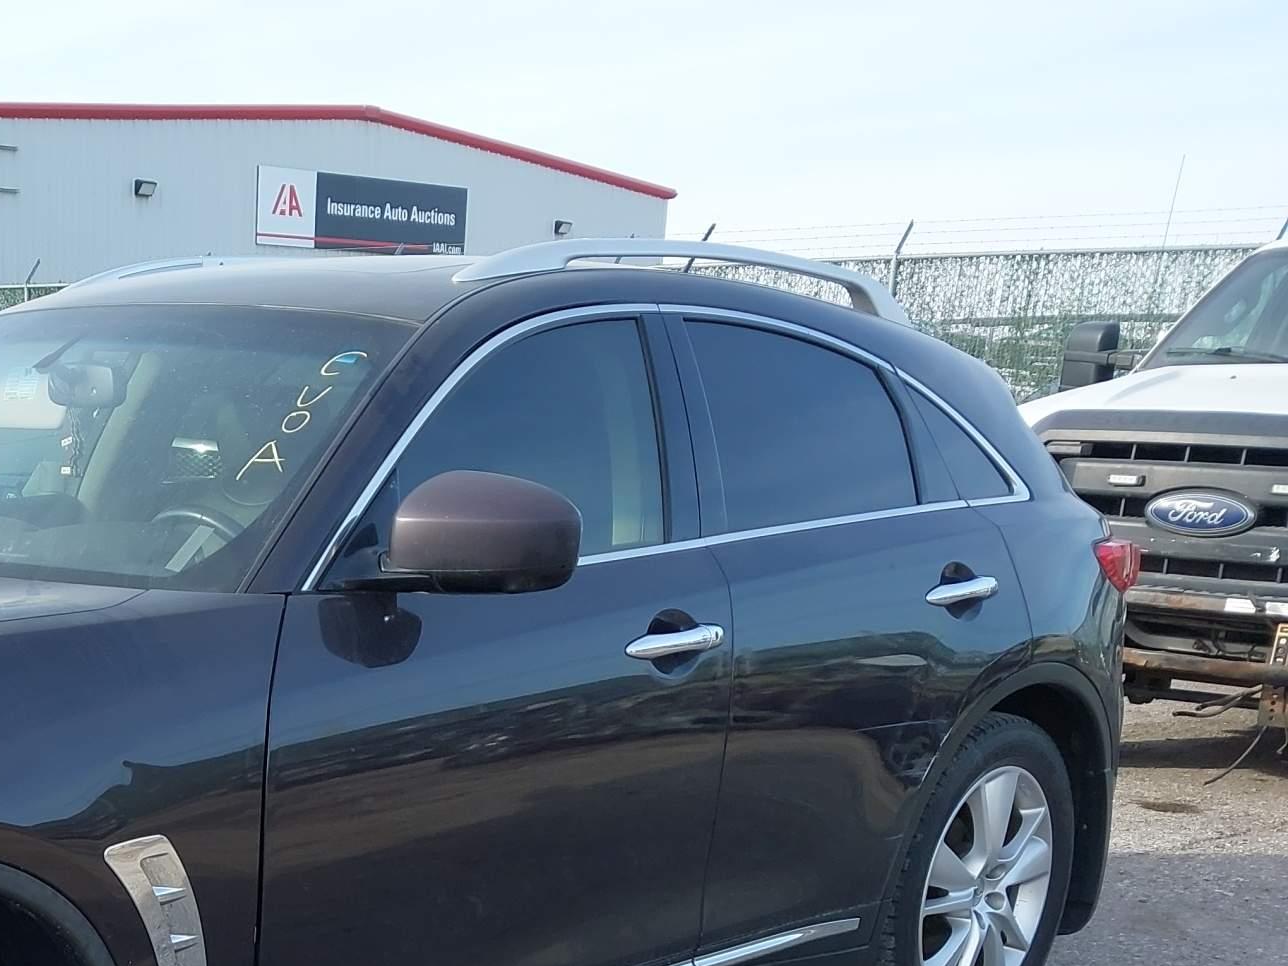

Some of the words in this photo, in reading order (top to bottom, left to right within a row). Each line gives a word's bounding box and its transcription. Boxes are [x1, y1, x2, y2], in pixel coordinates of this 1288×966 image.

[326, 197, 382, 219] Insurance
[383, 202, 409, 221] Auto
[410, 205, 456, 227] Auctions
[1168, 501, 1227, 525] Ford
